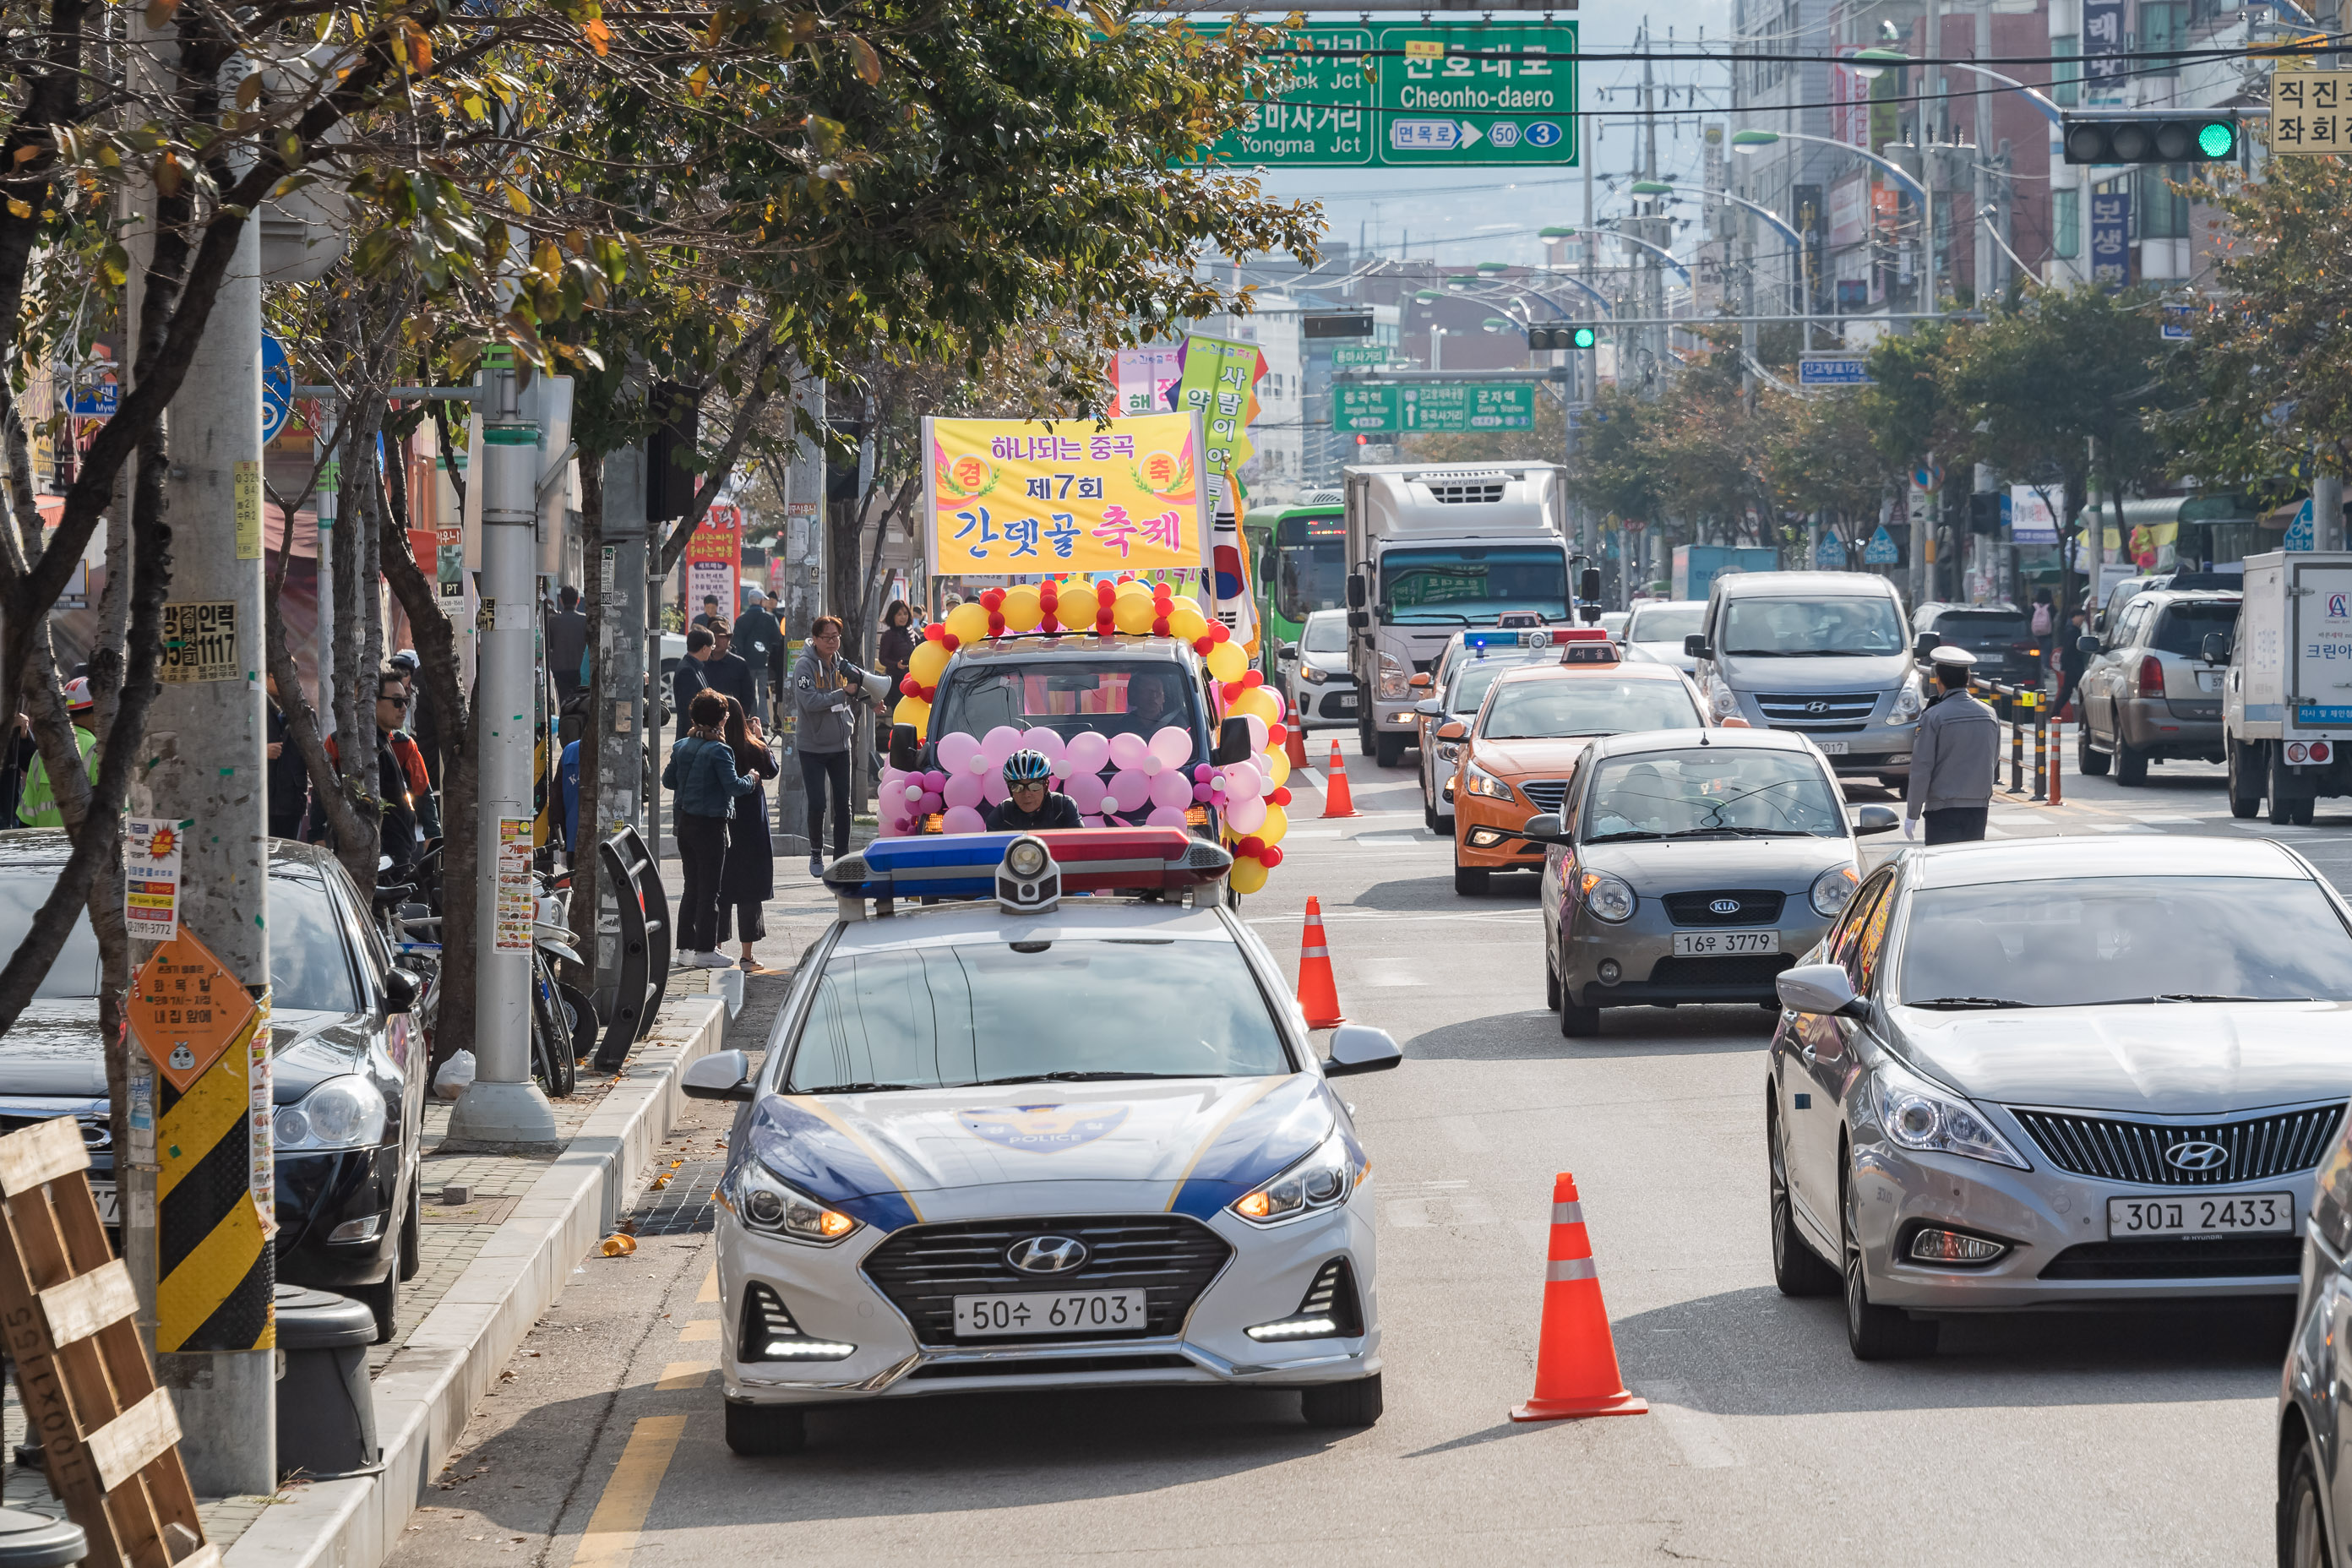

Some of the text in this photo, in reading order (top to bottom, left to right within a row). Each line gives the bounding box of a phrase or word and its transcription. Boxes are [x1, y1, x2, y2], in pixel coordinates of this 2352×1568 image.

[1331, 72, 1361, 89] Jct
[1400, 85, 1554, 107] Cheonho-daero
[2278, 79, 2352, 109] 직진
[1399, 126, 1451, 144] 면목로
[1494, 128, 1514, 142] 50
[1536, 126, 1550, 144] 3
[1243, 136, 1361, 157] Yongma Jct
[1212, 366, 1247, 443] 사람이
[1344, 391, 1382, 405] 중곡역
[1478, 390, 1516, 403] 군자역
[991, 433, 1135, 461] 하나되는 중곡
[959, 461, 981, 485] 경
[1148, 459, 1170, 483] 축
[1025, 473, 1103, 501] 제7회
[954, 504, 1181, 559] 간뎃골 축제
[446, 584, 459, 596] PT
[199, 603, 234, 633] 인력
[1507, 617, 1532, 626] 서울
[199, 634, 235, 664] 1117
[1576, 648, 1605, 660] 서울
[1714, 901, 1735, 912] KIA
[1684, 934, 1770, 953] 16우 3779
[155, 1009, 211, 1024] 내 집 앞에
[1009, 1133, 1082, 1144] POLICE
[2126, 1200, 2276, 1231] 30고 2433
[972, 1295, 1128, 1330] 50수 6703
